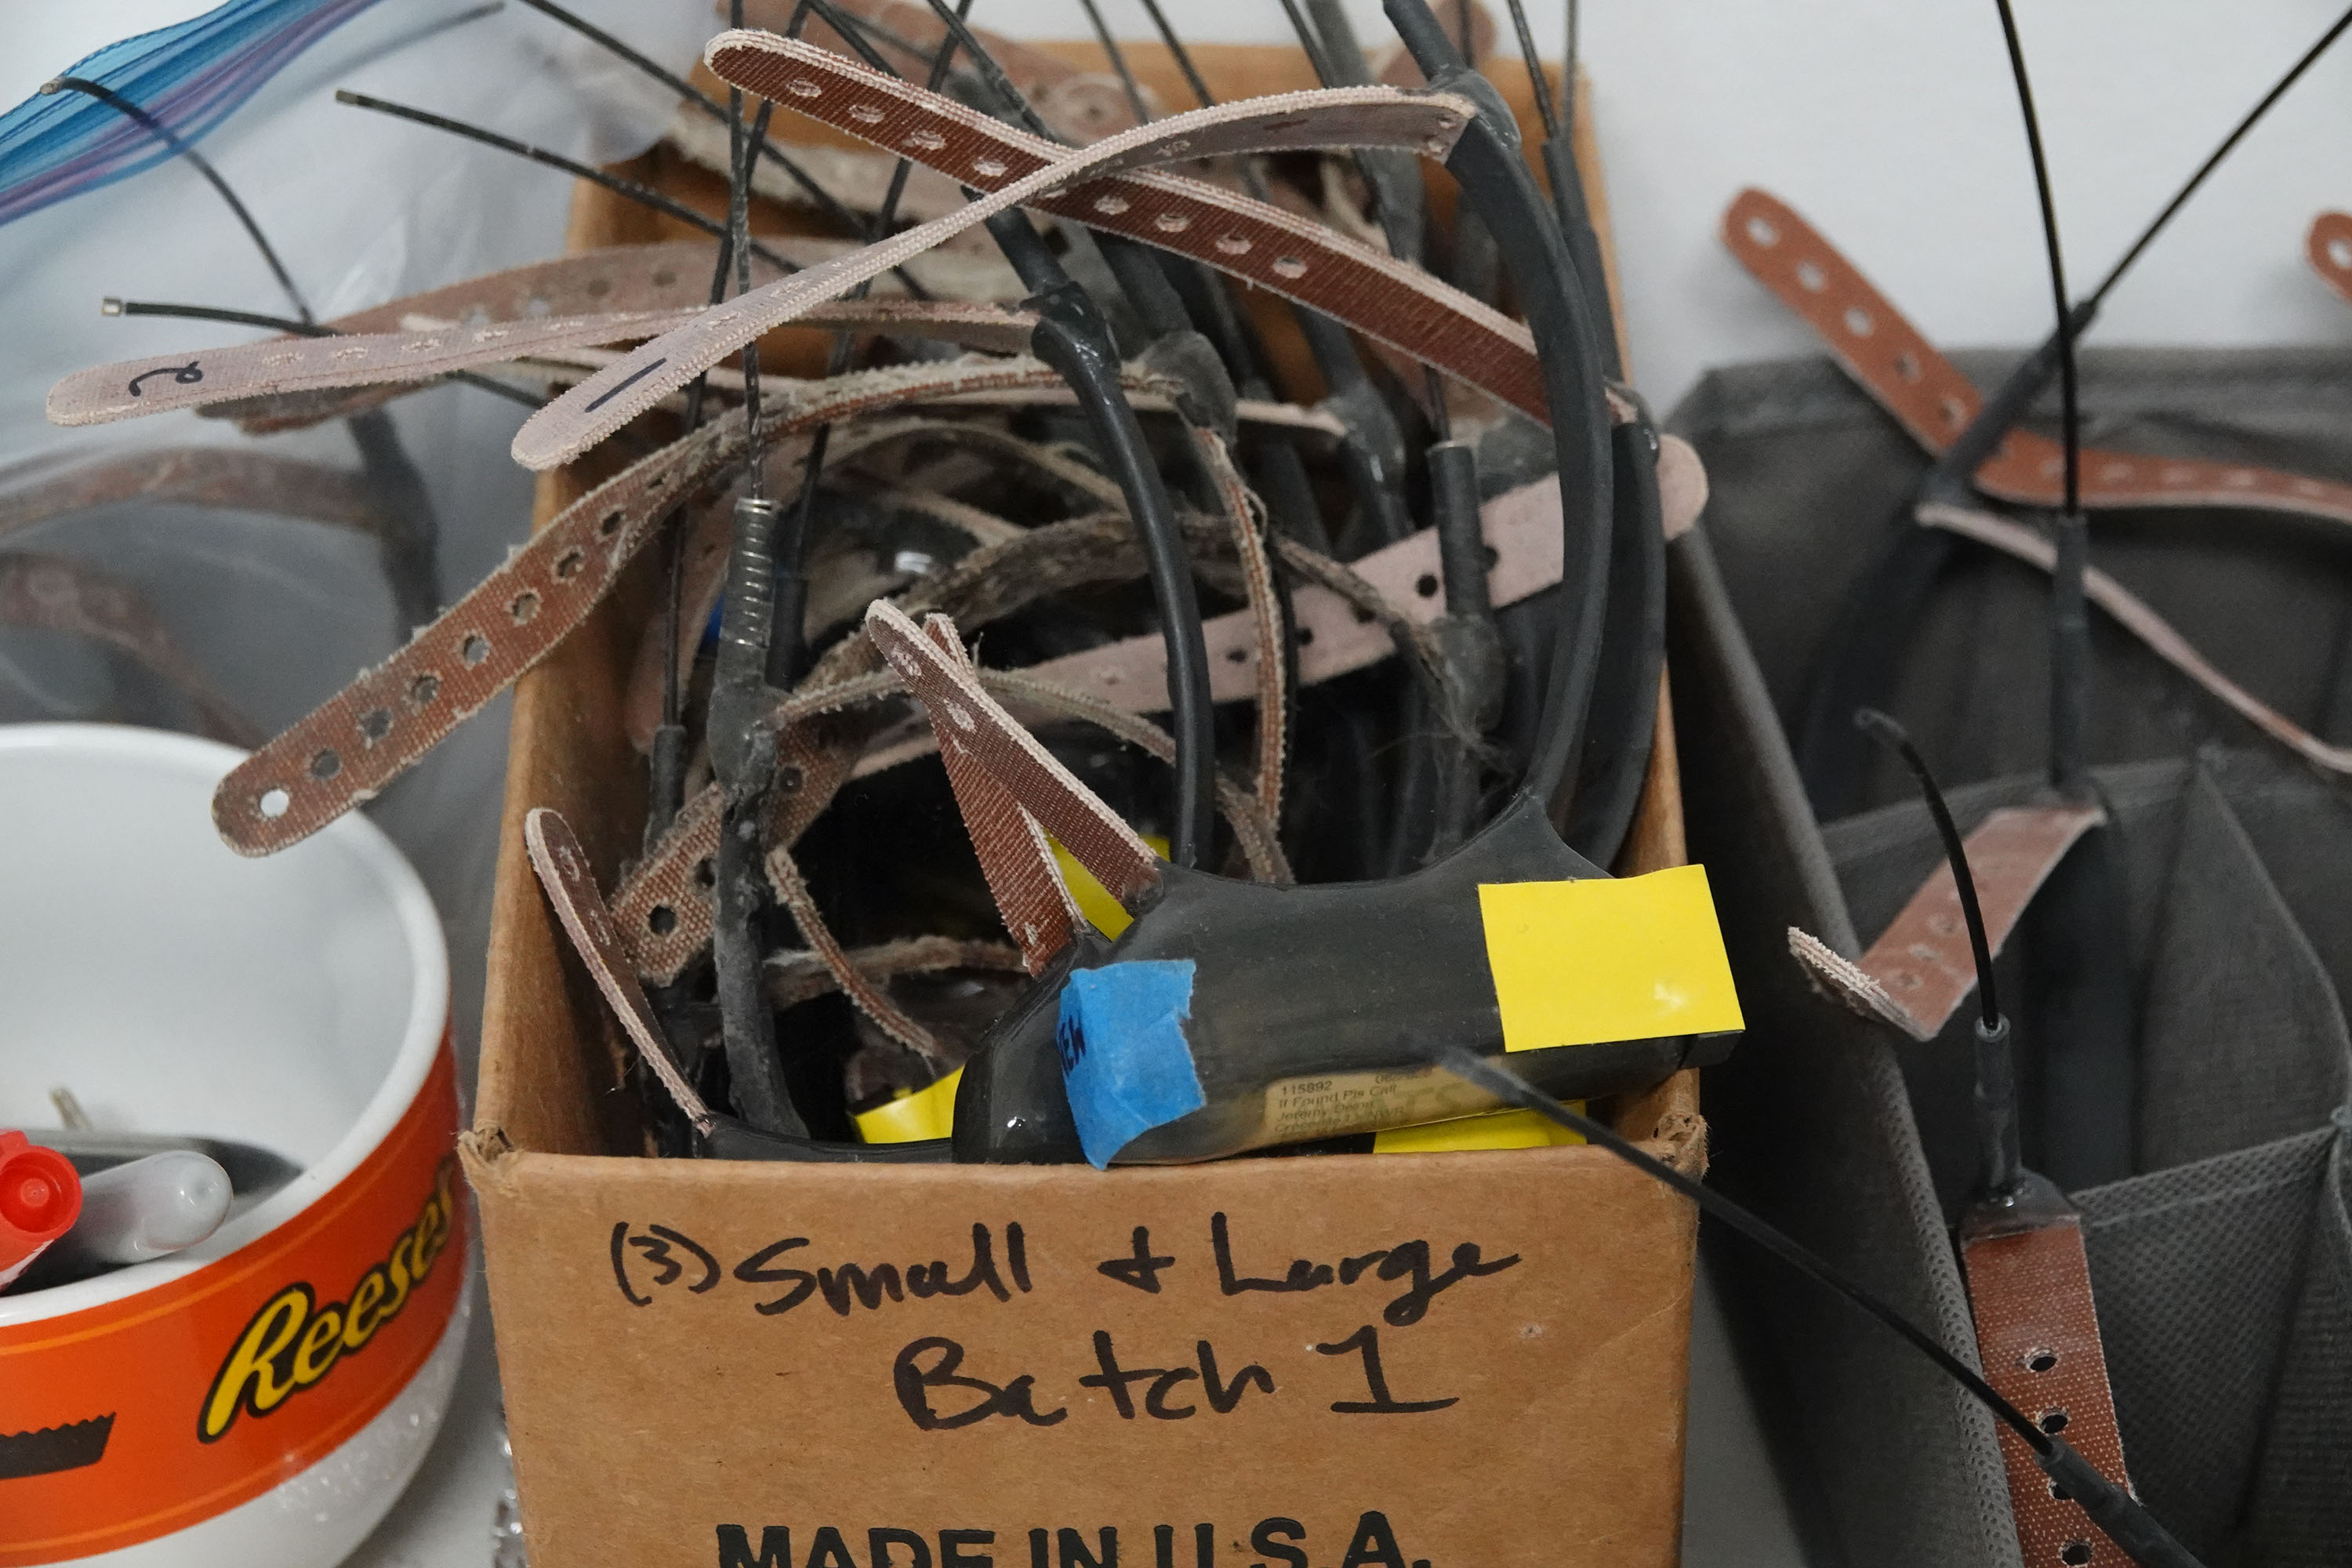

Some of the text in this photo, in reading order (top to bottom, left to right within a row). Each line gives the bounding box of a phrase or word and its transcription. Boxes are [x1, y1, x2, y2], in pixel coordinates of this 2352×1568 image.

[732, 1221, 1033, 1317] Small
[1210, 1211, 1523, 1328] Large
[1316, 1324, 1461, 1414] 1
